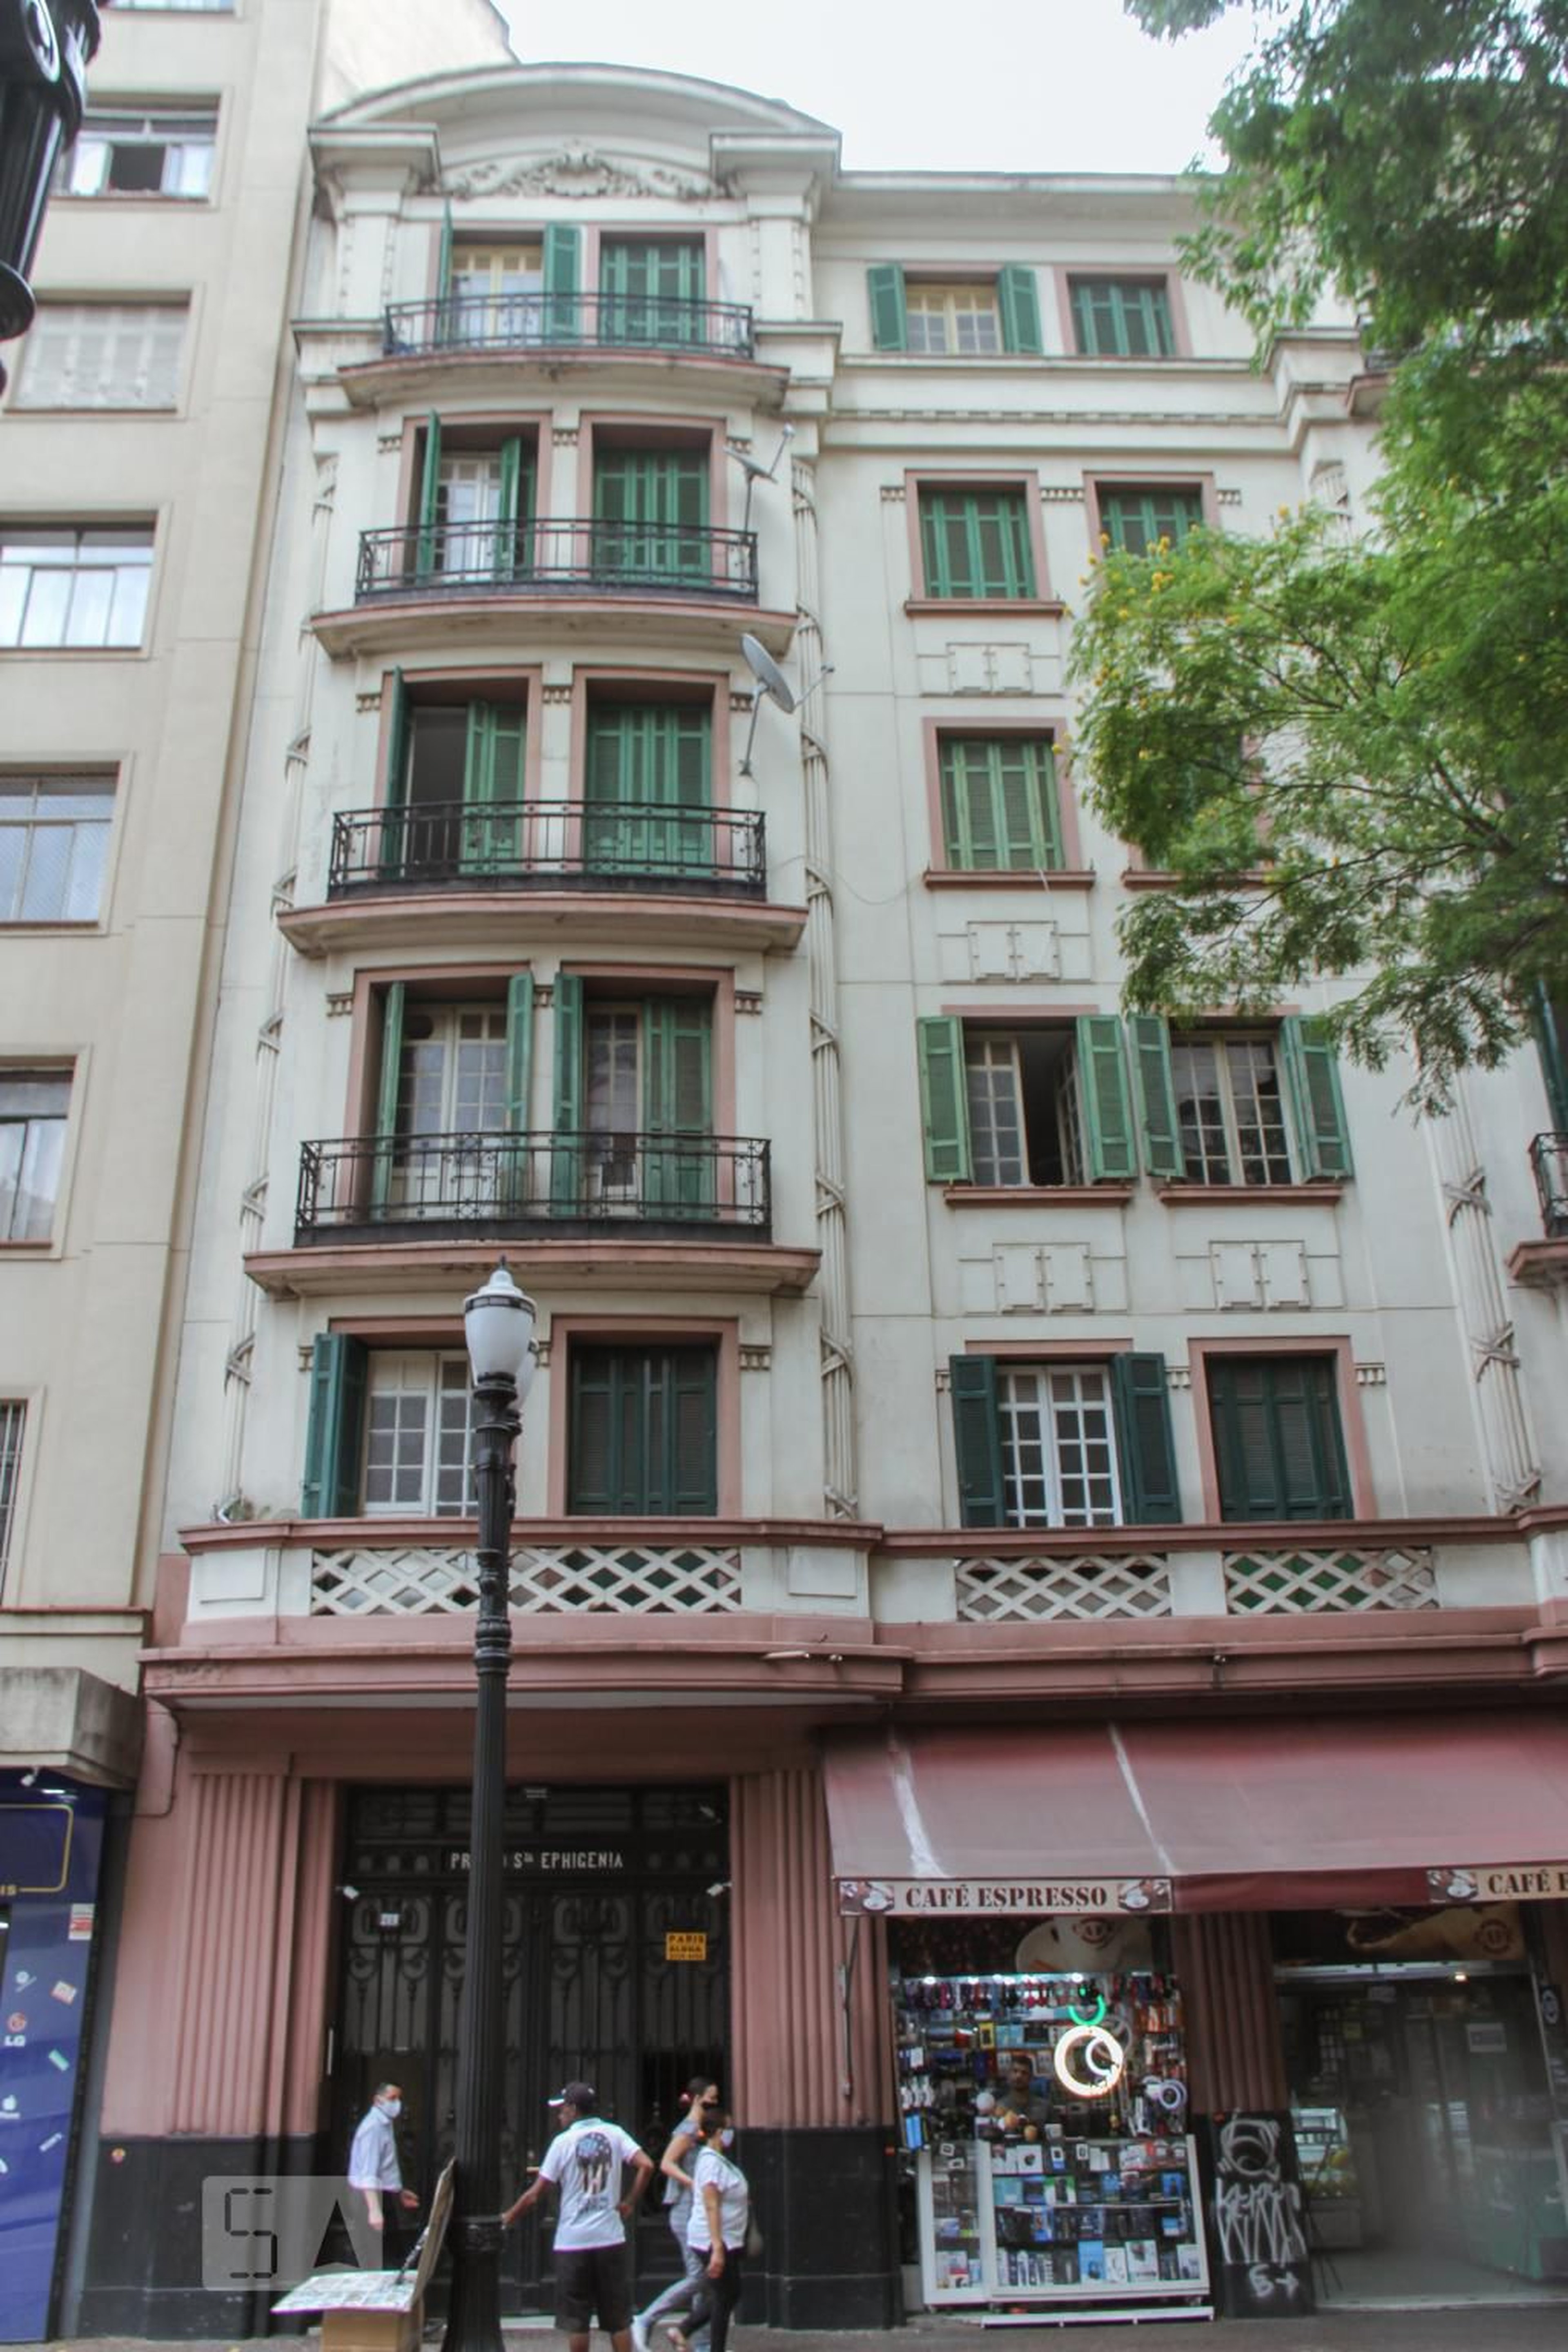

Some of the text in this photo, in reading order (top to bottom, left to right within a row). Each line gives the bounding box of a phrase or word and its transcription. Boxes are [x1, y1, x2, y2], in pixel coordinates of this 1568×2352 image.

[541, 1852, 623, 1869] EPHIGENIA
[1488, 1869, 1550, 1894] CAFÉ
[906, 1884, 1107, 1908] CAFÉ ESPRESSO
